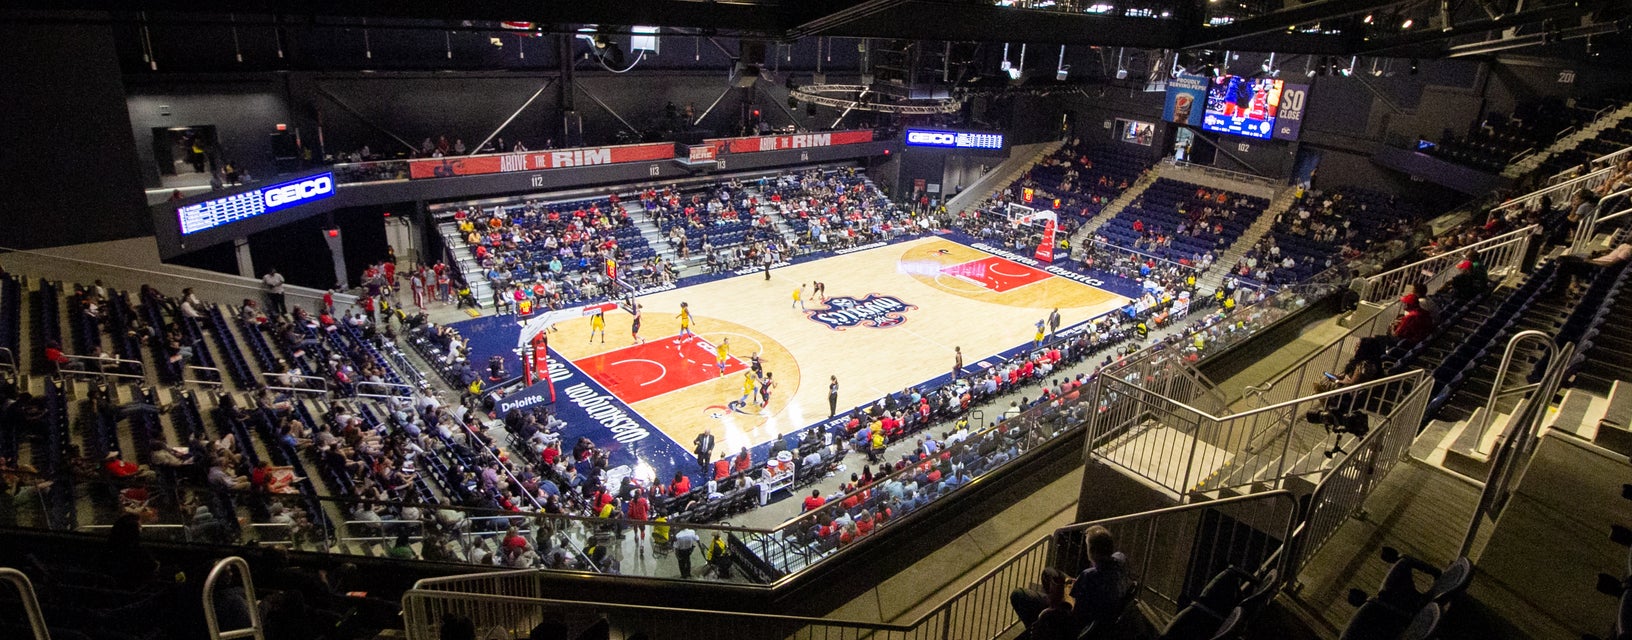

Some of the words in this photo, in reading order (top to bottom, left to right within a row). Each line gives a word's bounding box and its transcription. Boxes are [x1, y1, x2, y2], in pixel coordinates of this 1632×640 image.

[1558, 72, 1575, 83] 201
[1281, 89, 1305, 112] SO
[1279, 109, 1301, 120] CLOSE
[792, 133, 831, 149] RIM
[908, 132, 955, 145] GEICO
[1237, 143, 1250, 153] 102
[500, 153, 528, 172] ABOVE
[534, 154, 546, 168] THE
[552, 149, 612, 168] RIM
[717, 161, 726, 169] 113
[649, 166, 660, 176] 113
[531, 177, 543, 187] 112
[264, 176, 332, 208] GEICO
